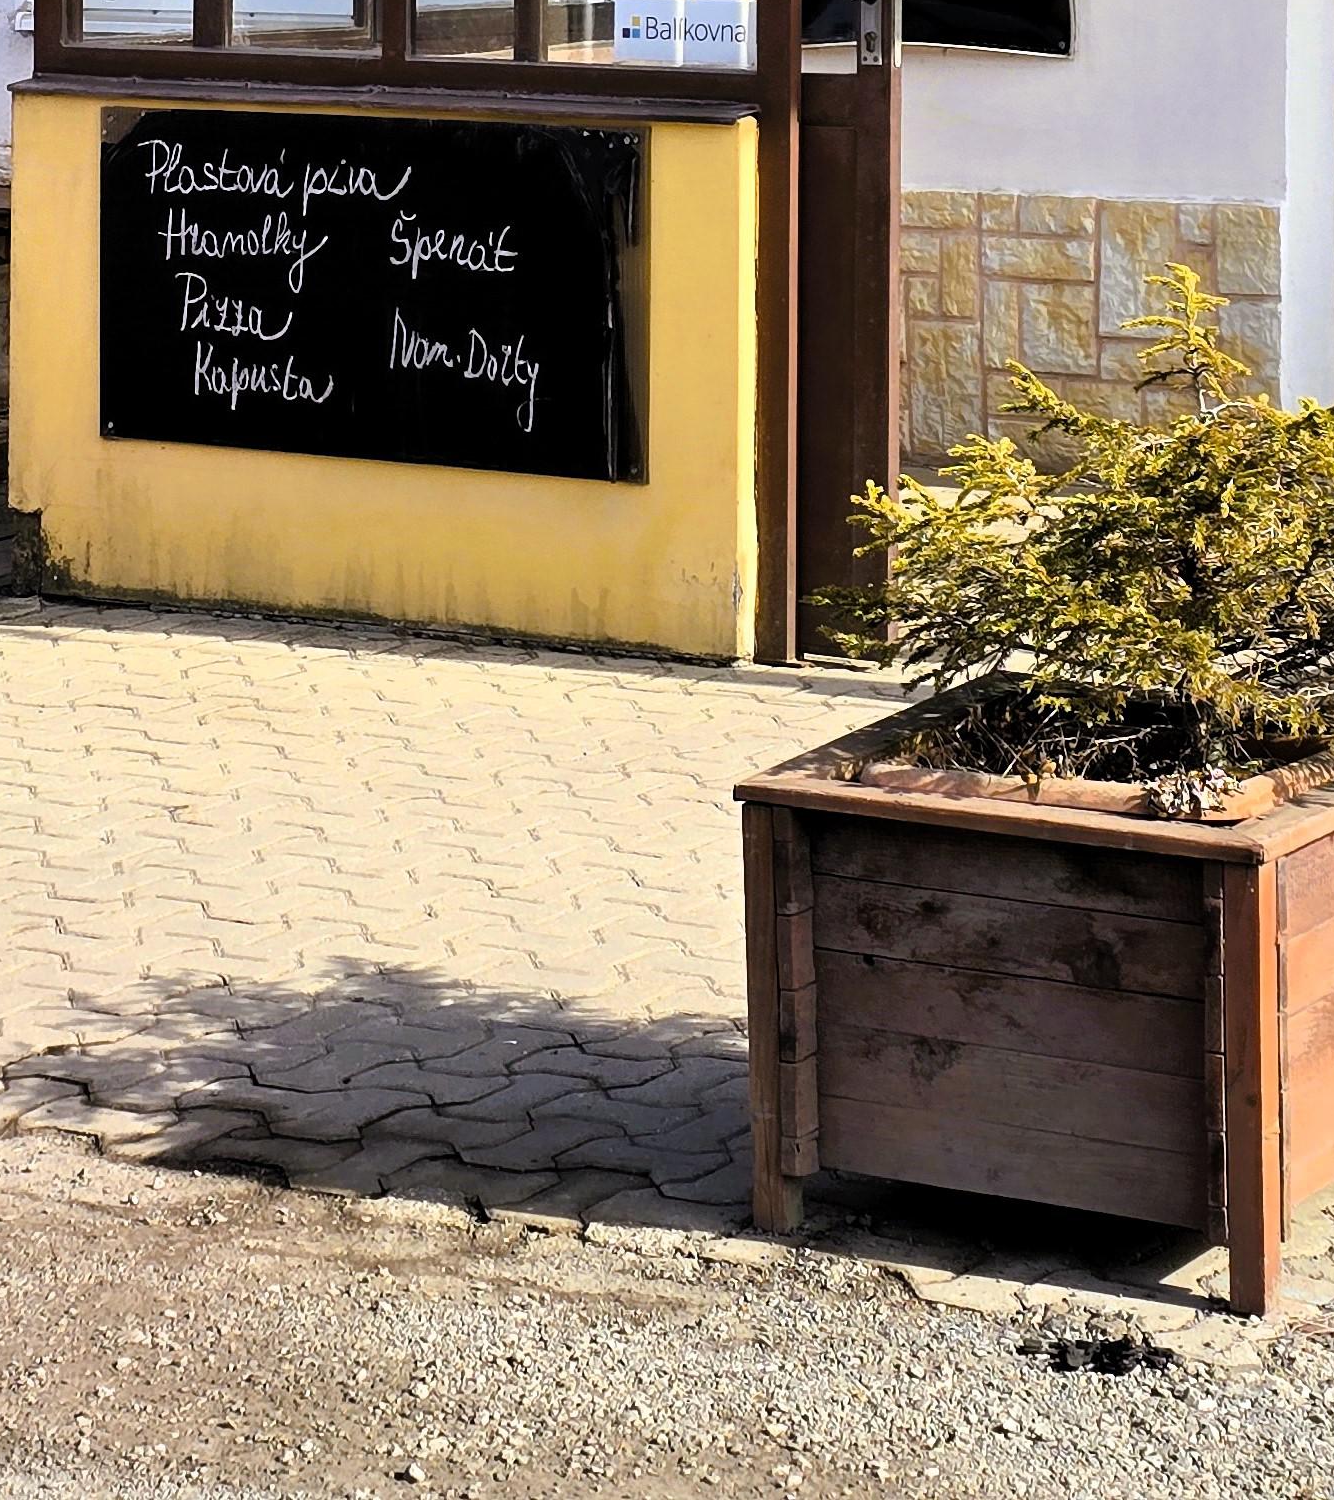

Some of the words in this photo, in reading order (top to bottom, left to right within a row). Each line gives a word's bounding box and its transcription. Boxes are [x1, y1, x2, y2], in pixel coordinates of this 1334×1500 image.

[643, 15, 748, 45] Balíkovna
[137, 138, 295, 198] Plastová
[157, 207, 329, 294] Hranolky
[389, 209, 519, 280] Špenát
[174, 271, 293, 341] Pizza
[193, 340, 334, 411] Kapusta
